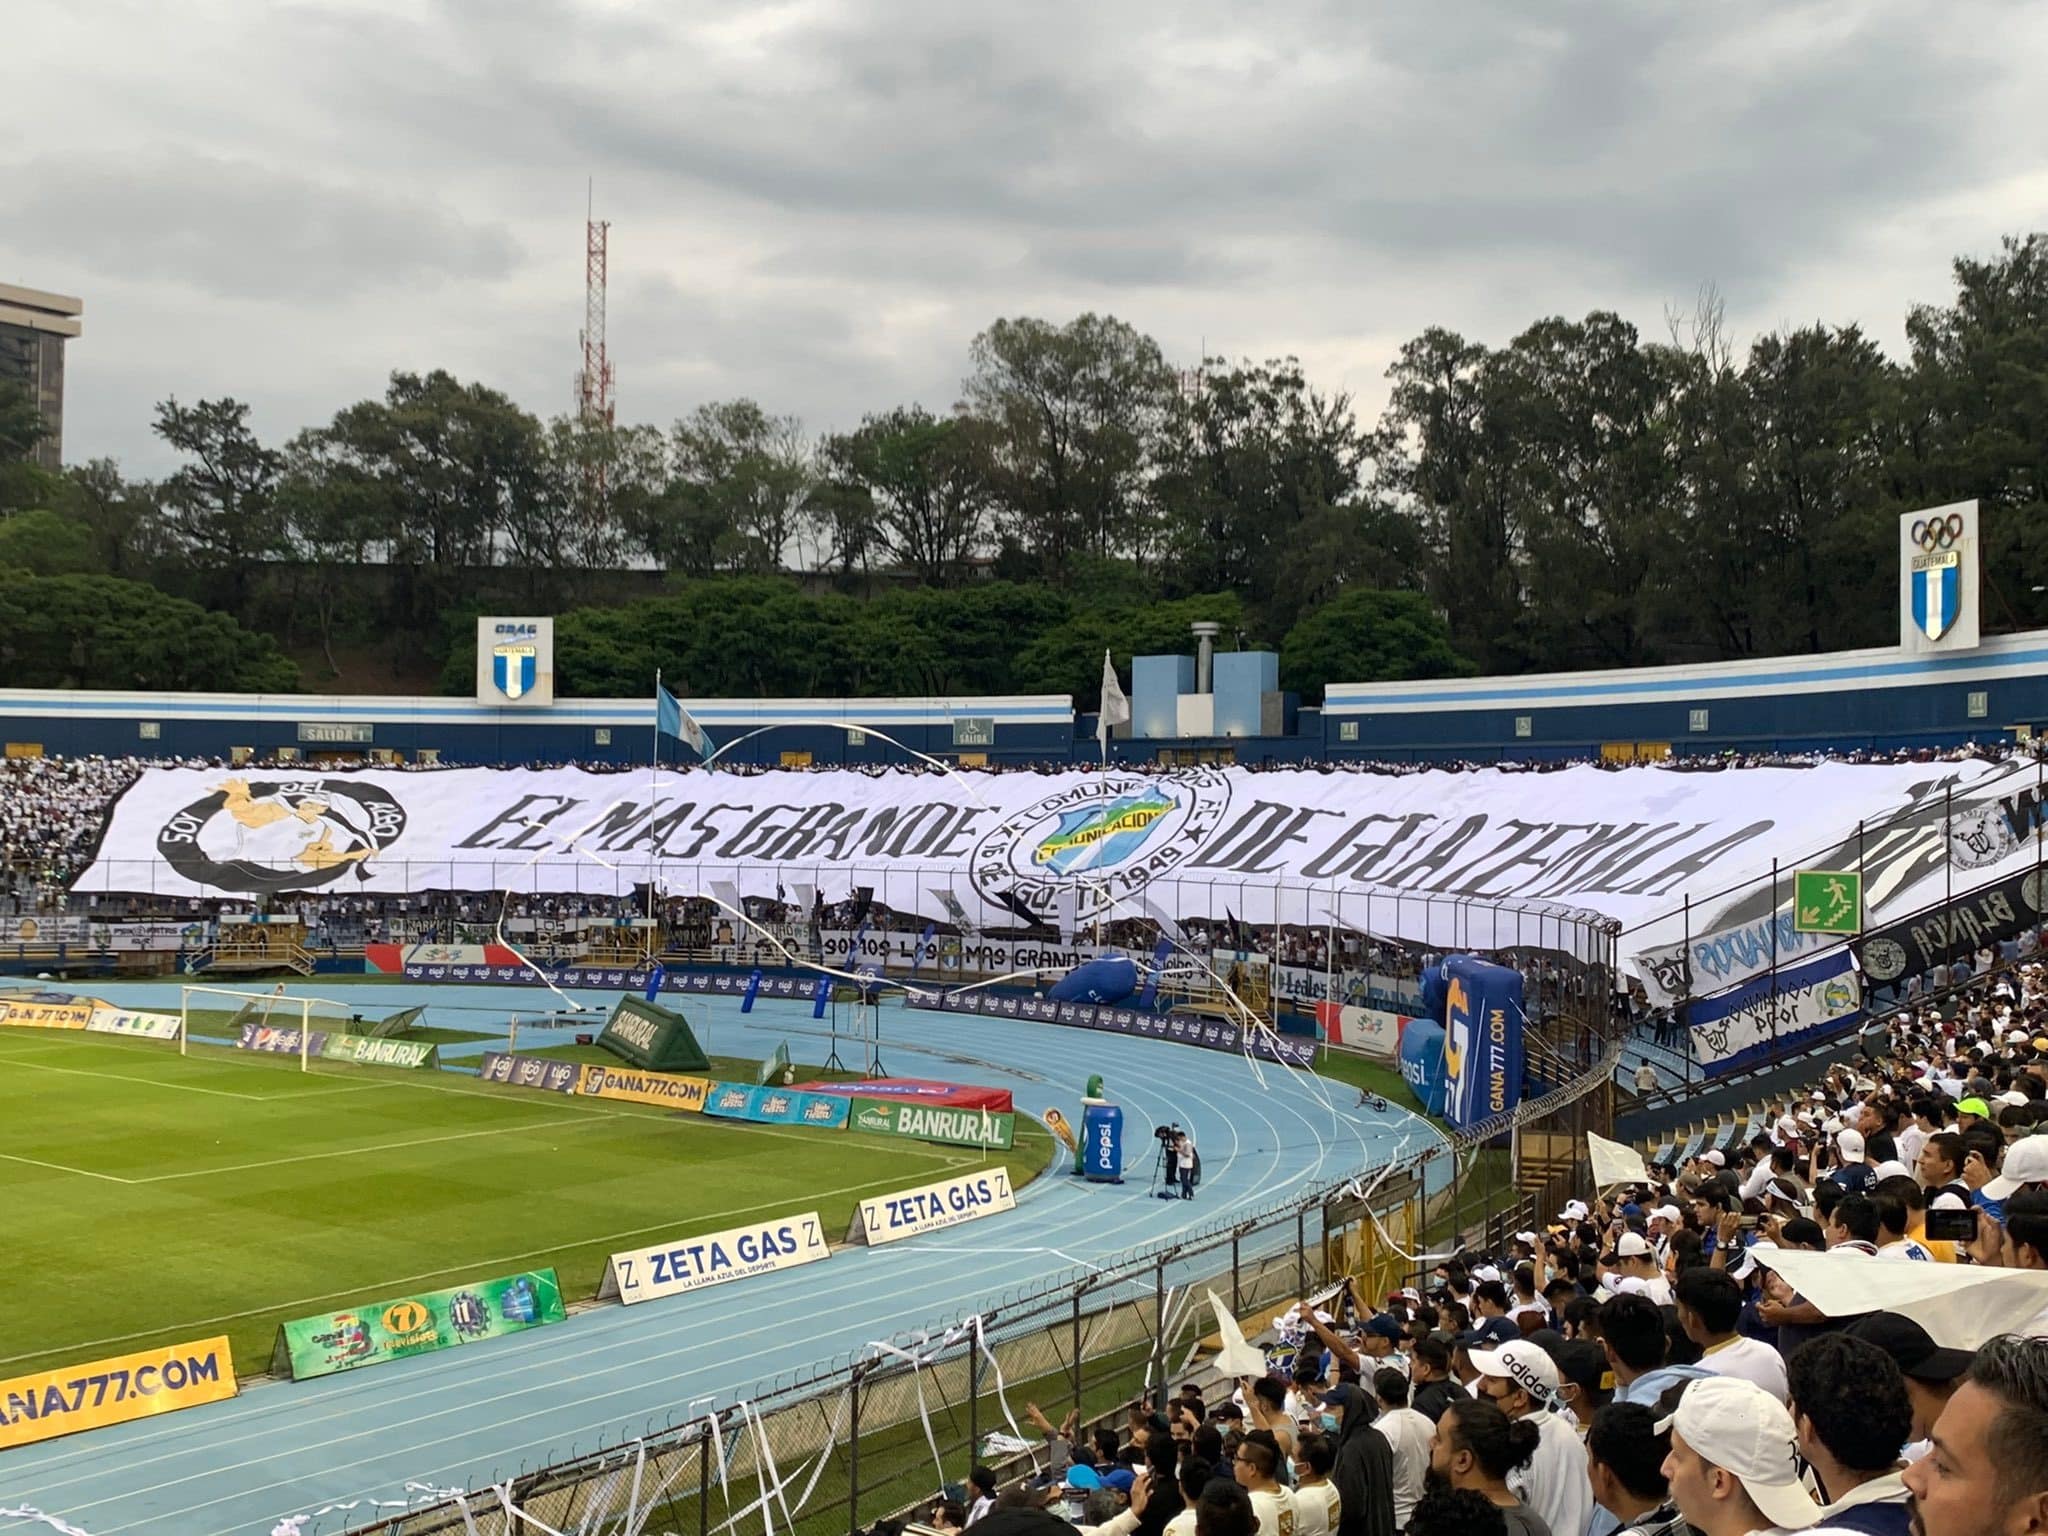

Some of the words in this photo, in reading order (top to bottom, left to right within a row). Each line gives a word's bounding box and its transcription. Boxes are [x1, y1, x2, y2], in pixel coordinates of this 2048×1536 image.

[307, 728, 353, 740] SALIDA
[279, 780, 332, 796] DEL
[162, 811, 204, 845] SOY
[451, 794, 589, 850] EL
[558, 797, 753, 859] MAS
[716, 801, 1002, 861] GRANDE
[1184, 799, 1346, 874] DE
[966, 943, 1006, 970] MAS
[1286, 971, 1328, 999] Leales
[611, 1010, 659, 1050] BANRURAL
[354, 1038, 431, 1068] BANRURAL
[1489, 1009, 1505, 1112] GANA777.COM
[520, 1059, 541, 1081] tigo
[551, 1064, 573, 1085] tigo
[604, 1073, 702, 1101] GANA777.COM
[898, 1106, 1004, 1145] BANRURAL
[1098, 1123, 1114, 1169] pepsi
[994, 1174, 1009, 1199] Z
[865, 1206, 881, 1231] Z
[885, 1192, 945, 1229] ZETA
[948, 1179, 992, 1211] GAS
[802, 1220, 820, 1248] Z
[649, 1241, 732, 1285] ZETA
[737, 1227, 797, 1263] GAS
[618, 1260, 639, 1290] Z
[683, 1279, 693, 1288] LA
[693, 1275, 715, 1286] LLAMA
[717, 1271, 735, 1282] AZUL
[735, 1268, 747, 1277] DEL
[748, 1260, 776, 1275] DEPORTE
[1502, 1353, 1551, 1399] adidas
